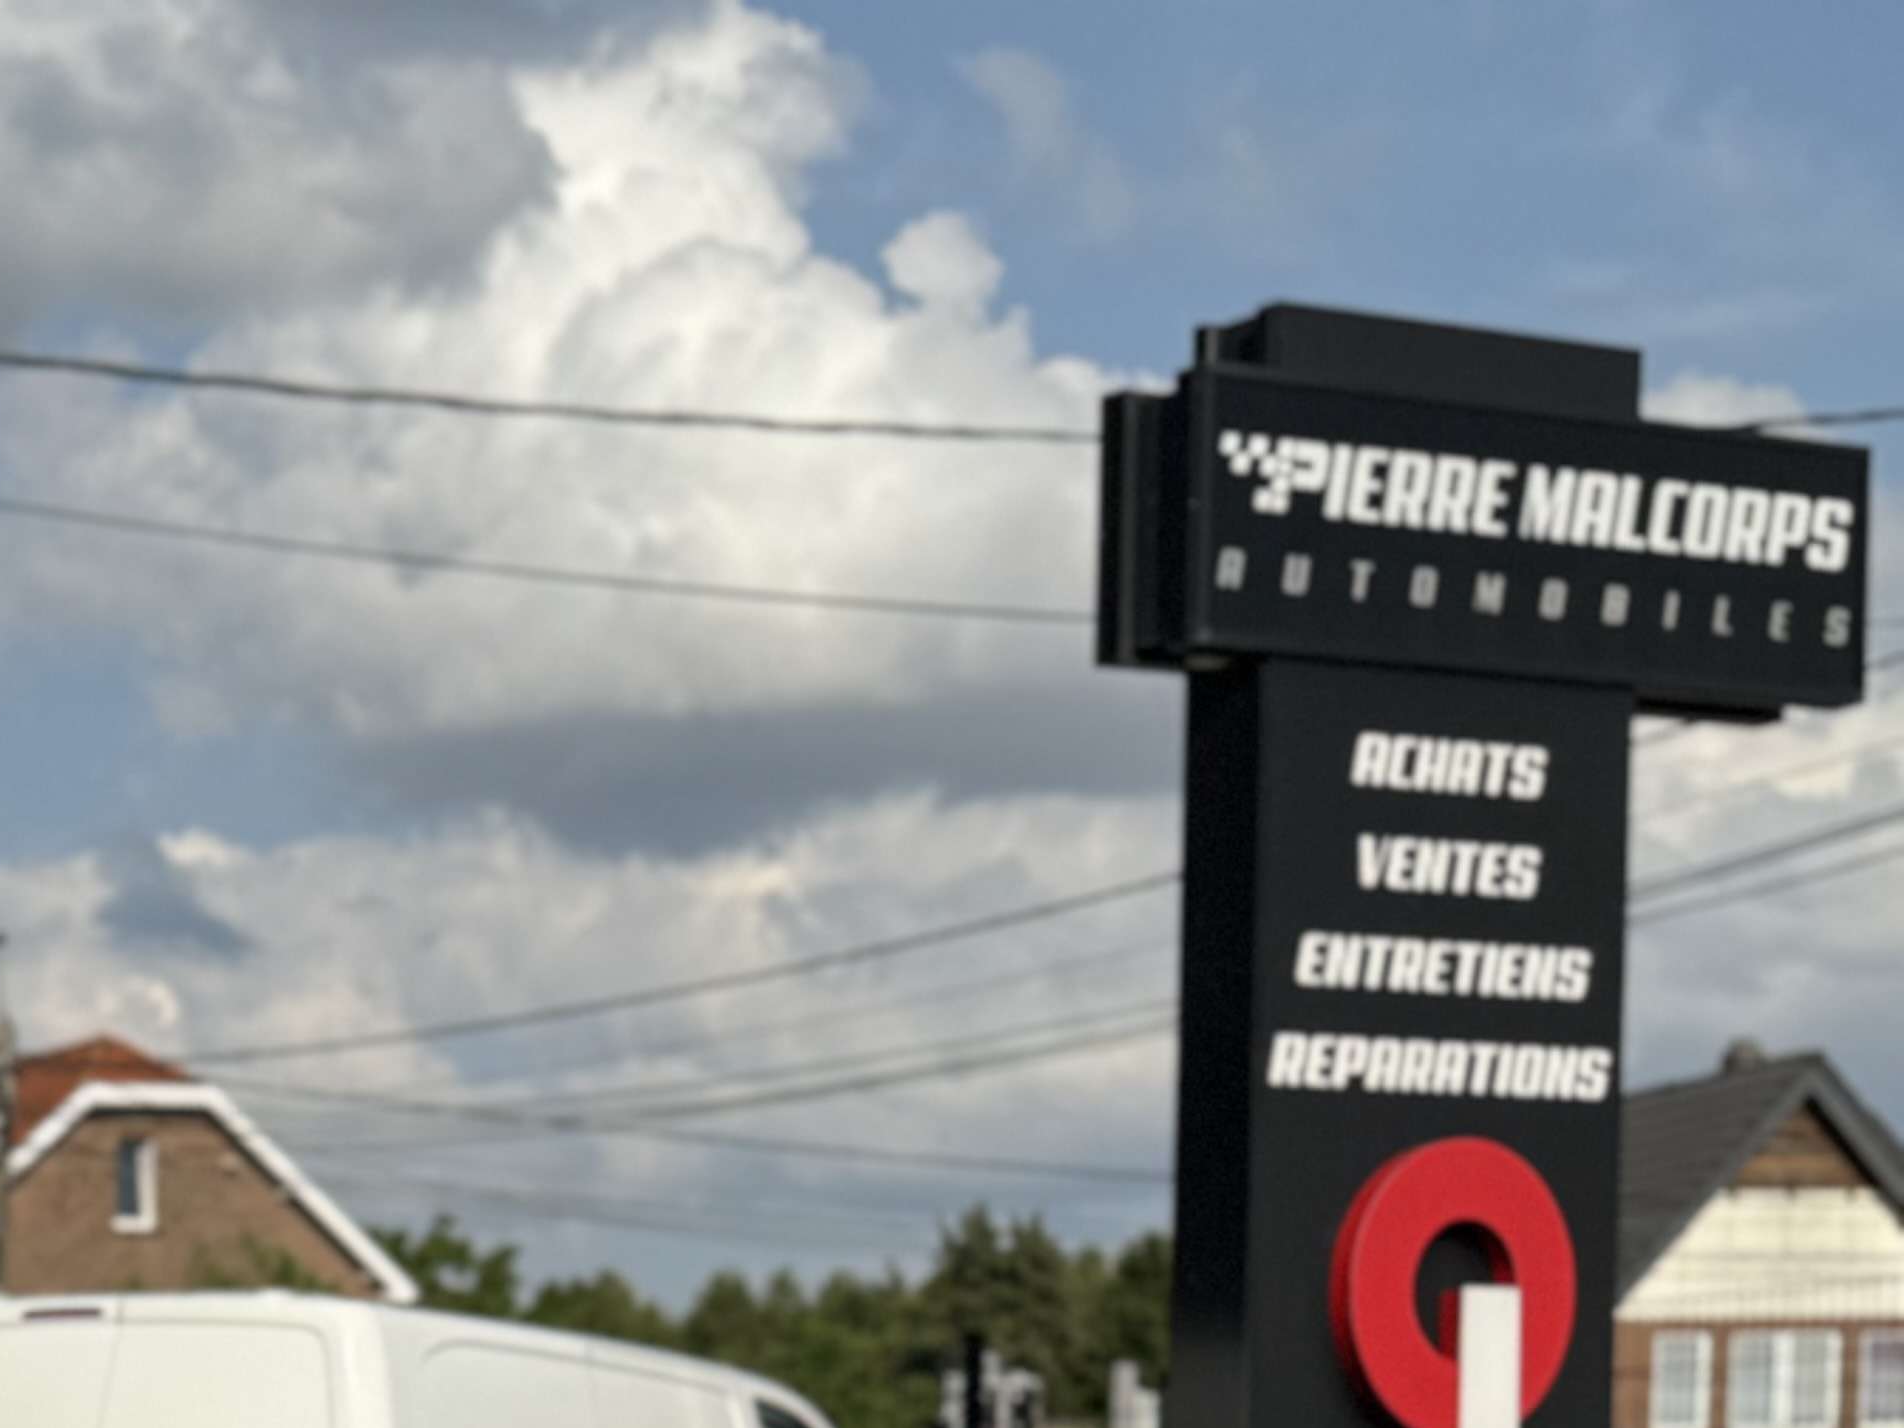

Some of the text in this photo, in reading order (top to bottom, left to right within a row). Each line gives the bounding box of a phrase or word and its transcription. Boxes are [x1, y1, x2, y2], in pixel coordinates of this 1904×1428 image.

[1252, 432, 1854, 573] PIERRE MALCORPS
[1350, 730, 1549, 801] ACHATS
[1356, 832, 1543, 900] VENTES
[1294, 930, 1593, 1002] ENTRETIENS
[1266, 1030, 1613, 1103] REPARATIONS
